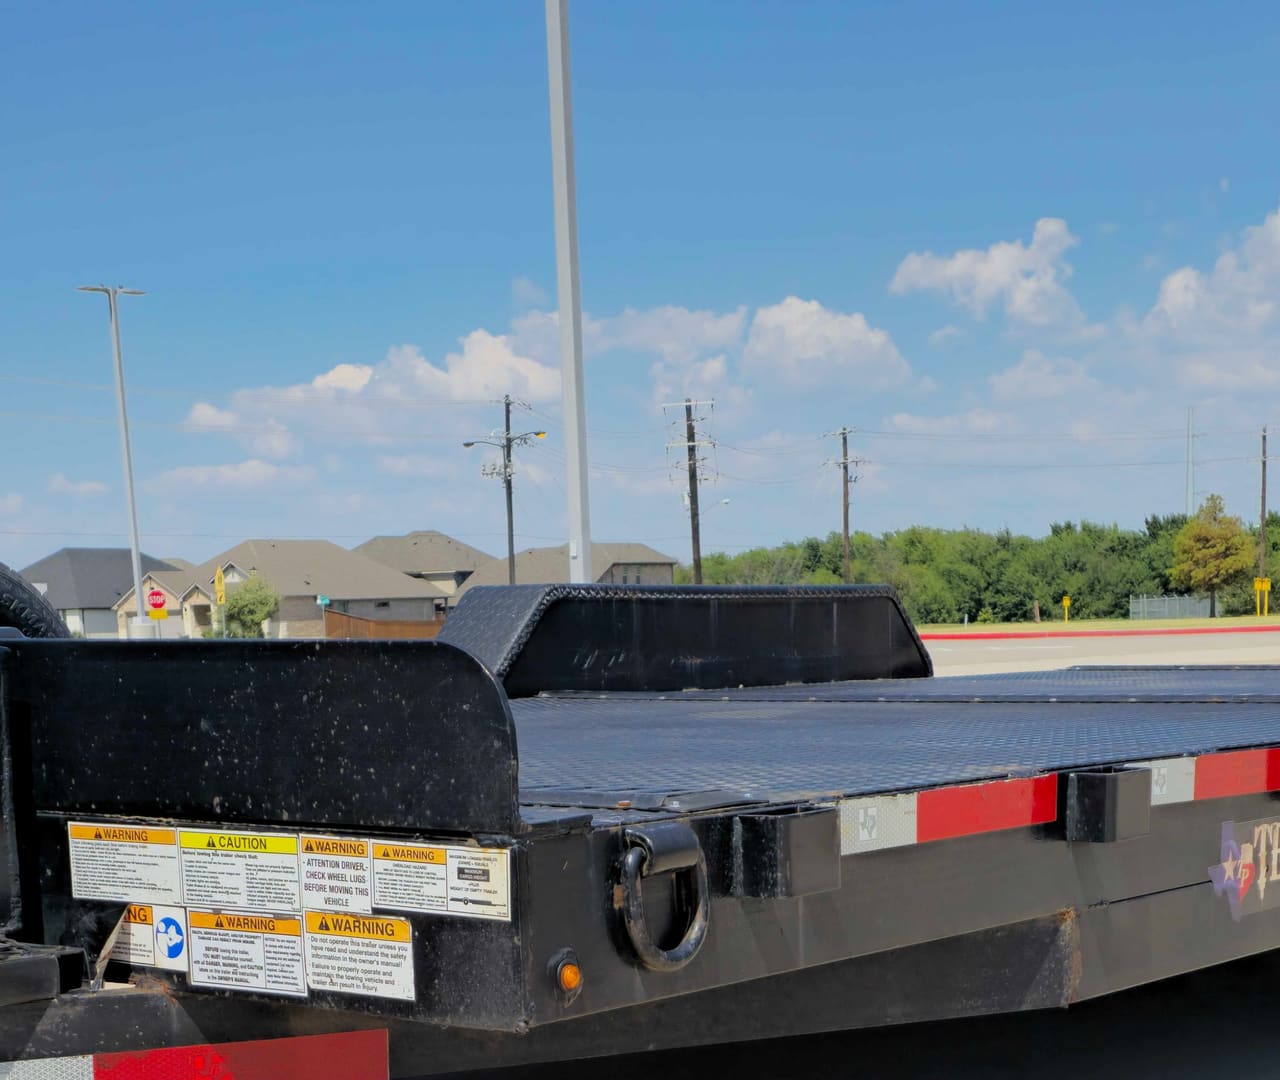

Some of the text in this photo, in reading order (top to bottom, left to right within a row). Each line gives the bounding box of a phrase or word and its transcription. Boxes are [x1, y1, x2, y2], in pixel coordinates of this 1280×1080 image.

[149, 595, 166, 604] STOP
[103, 829, 148, 841] WARNING
[218, 836, 267, 850] CAUTION
[315, 841, 365, 855] WARNING
[392, 849, 434, 861] WARNING
[307, 858, 340, 869] ATTENTION
[306, 870, 366, 884] CHECK WHEEL LUGS
[304, 883, 369, 896] BEFORE MOVING THIS
[323, 897, 349, 907] VEHICLE
[226, 917, 275, 931] WARNING
[332, 918, 394, 936] WARNING
[349, 949, 379, 957] understand
[390, 952, 406, 961] safety
[312, 962, 329, 970] Failure
[337, 966, 359, 974] properly
[360, 968, 380, 976] operate
[345, 975, 364, 983] towing
